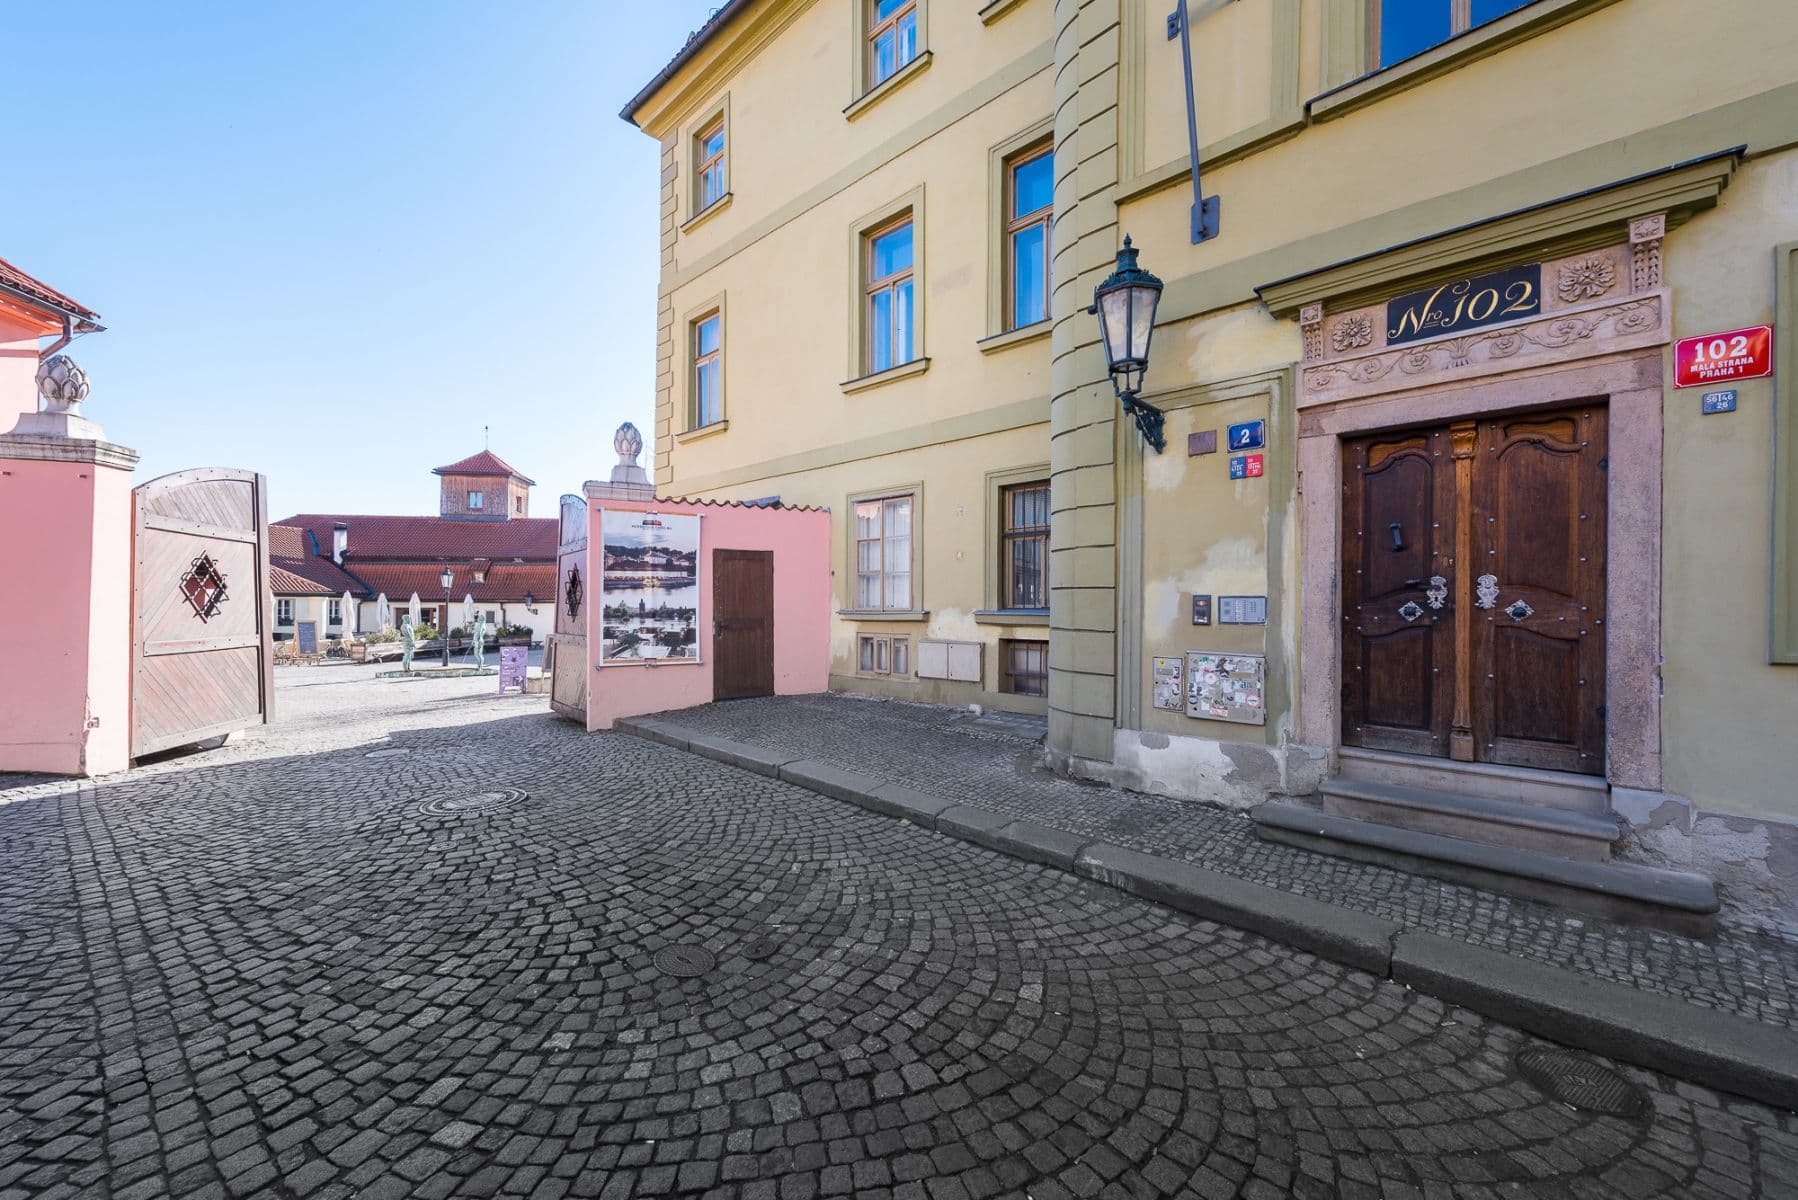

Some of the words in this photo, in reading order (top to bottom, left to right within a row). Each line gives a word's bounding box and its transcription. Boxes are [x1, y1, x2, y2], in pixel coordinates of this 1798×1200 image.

[1695, 336, 1747, 362] 102
[1718, 356, 1754, 367] STRANA
[1700, 367, 1734, 378] PRAHA
[1241, 428, 1250, 444] 2
